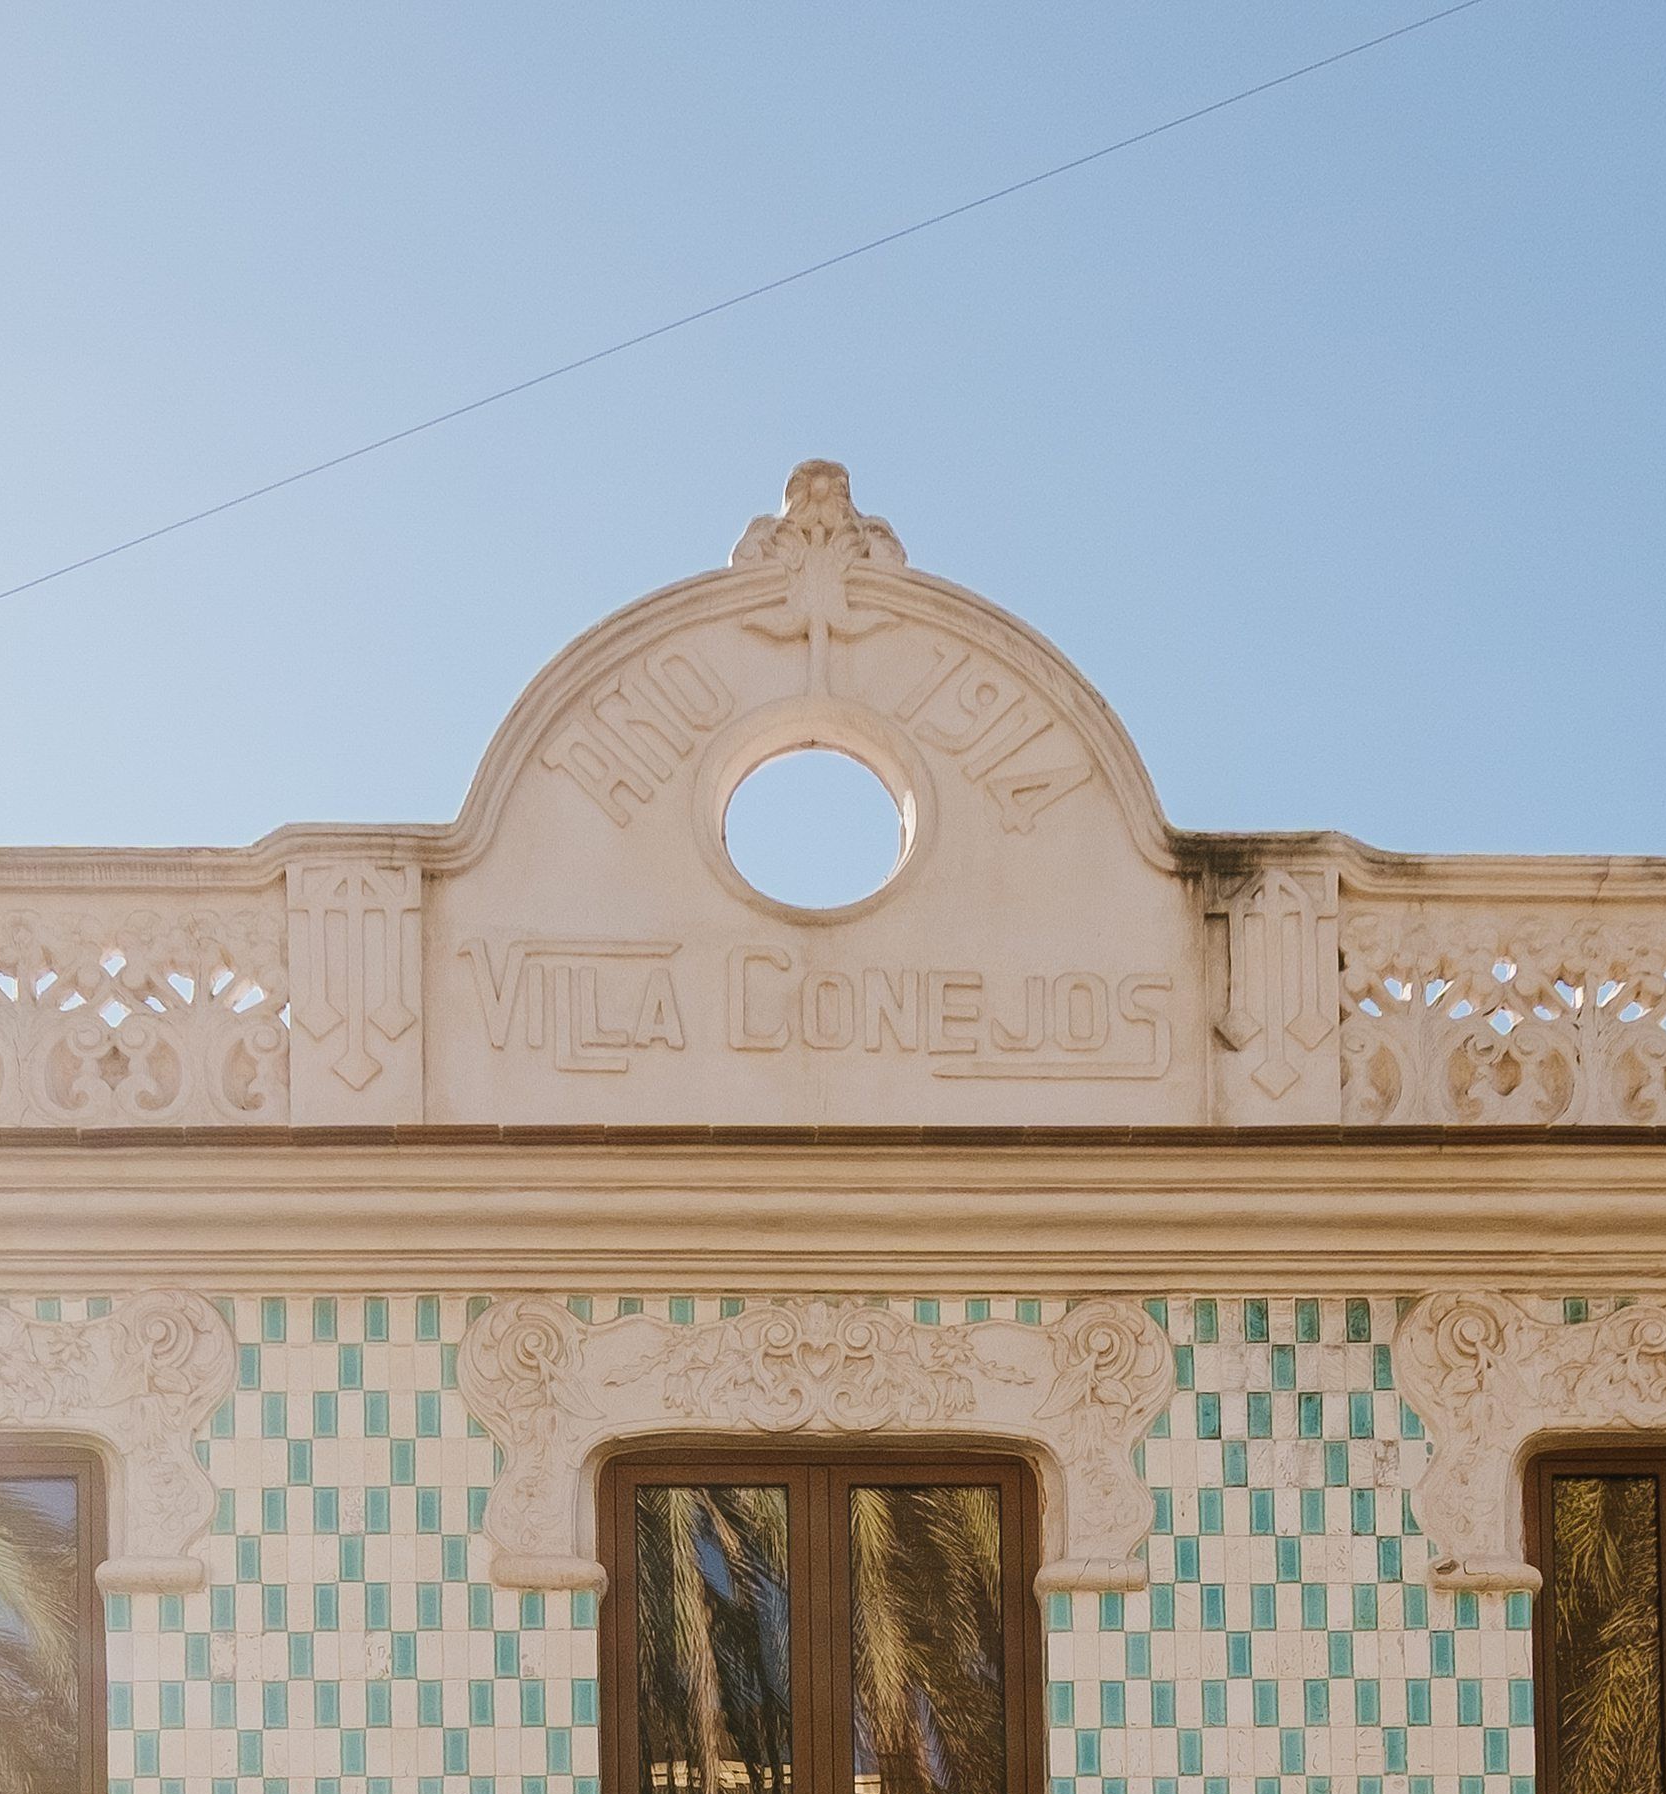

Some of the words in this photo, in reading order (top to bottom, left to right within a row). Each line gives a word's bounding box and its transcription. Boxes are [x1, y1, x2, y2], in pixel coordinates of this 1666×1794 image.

[895, 646, 1094, 836] 1914
[456, 938, 686, 1074] VILLA
[728, 945, 1174, 1080] CONEJOS
